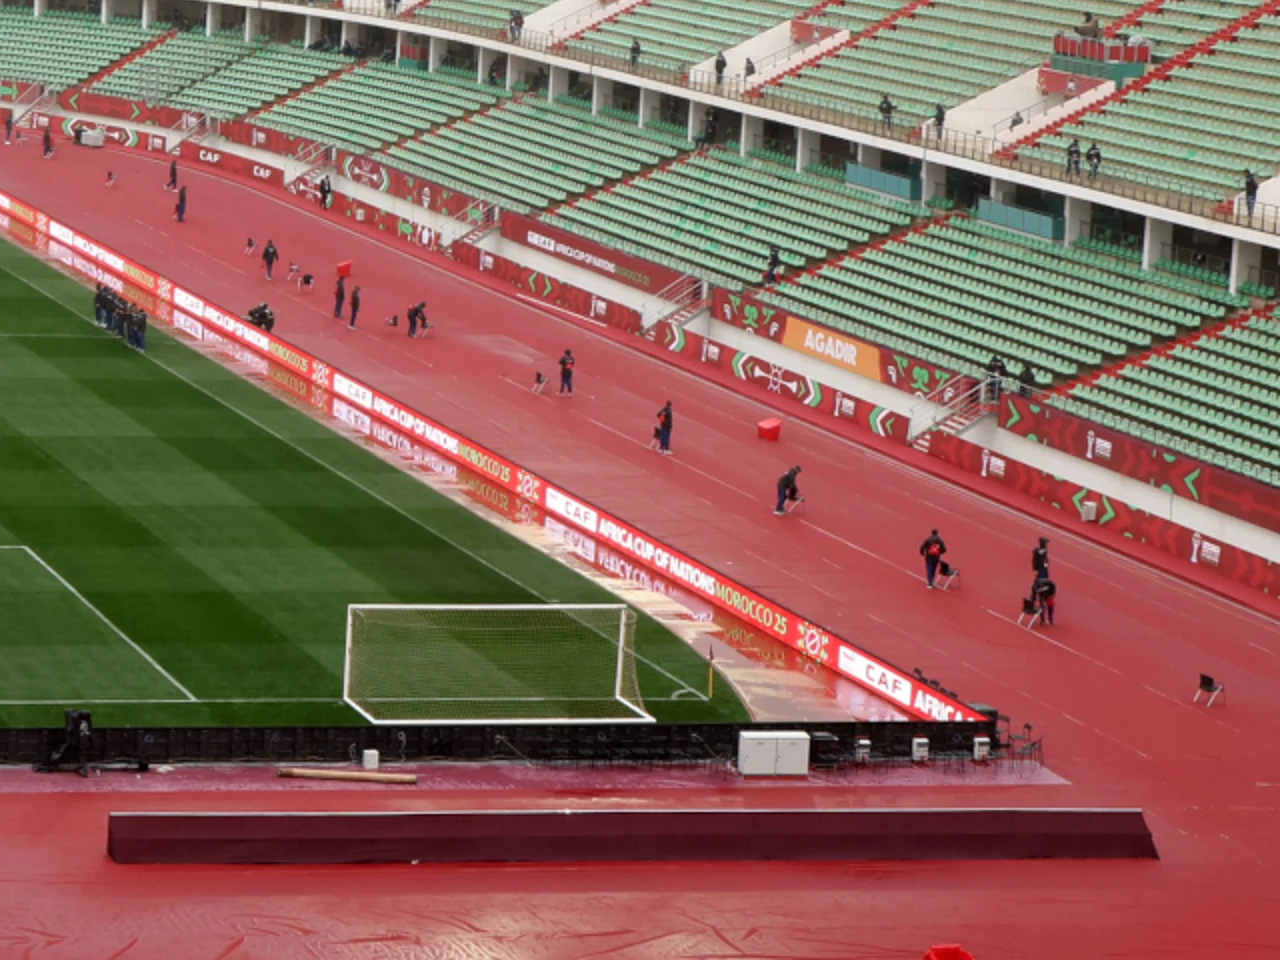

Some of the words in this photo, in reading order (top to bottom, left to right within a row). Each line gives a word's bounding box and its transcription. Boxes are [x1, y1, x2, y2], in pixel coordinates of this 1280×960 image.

[199, 150, 220, 163] CAF
[253, 165, 271, 179] CAF
[804, 329, 857, 365] AGADIR
[347, 384, 367, 402] CAF
[373, 397, 399, 422] AFRICA
[399, 411, 414, 429] CUP
[413, 417, 425, 434] OF
[425, 423, 459, 454] NATIONS
[459, 443, 500, 476] MOROCCO
[499, 464, 511, 482] 25
[564, 500, 591, 522] CAF
[599, 518, 634, 552] AFRICA
[634, 538, 654, 560] CUP
[654, 549, 670, 568] OF
[670, 556, 715, 594] NATIONS
[715, 582, 773, 627] MOROCCO
[773, 613, 787, 635] 25
[865, 664, 903, 694] CAF
